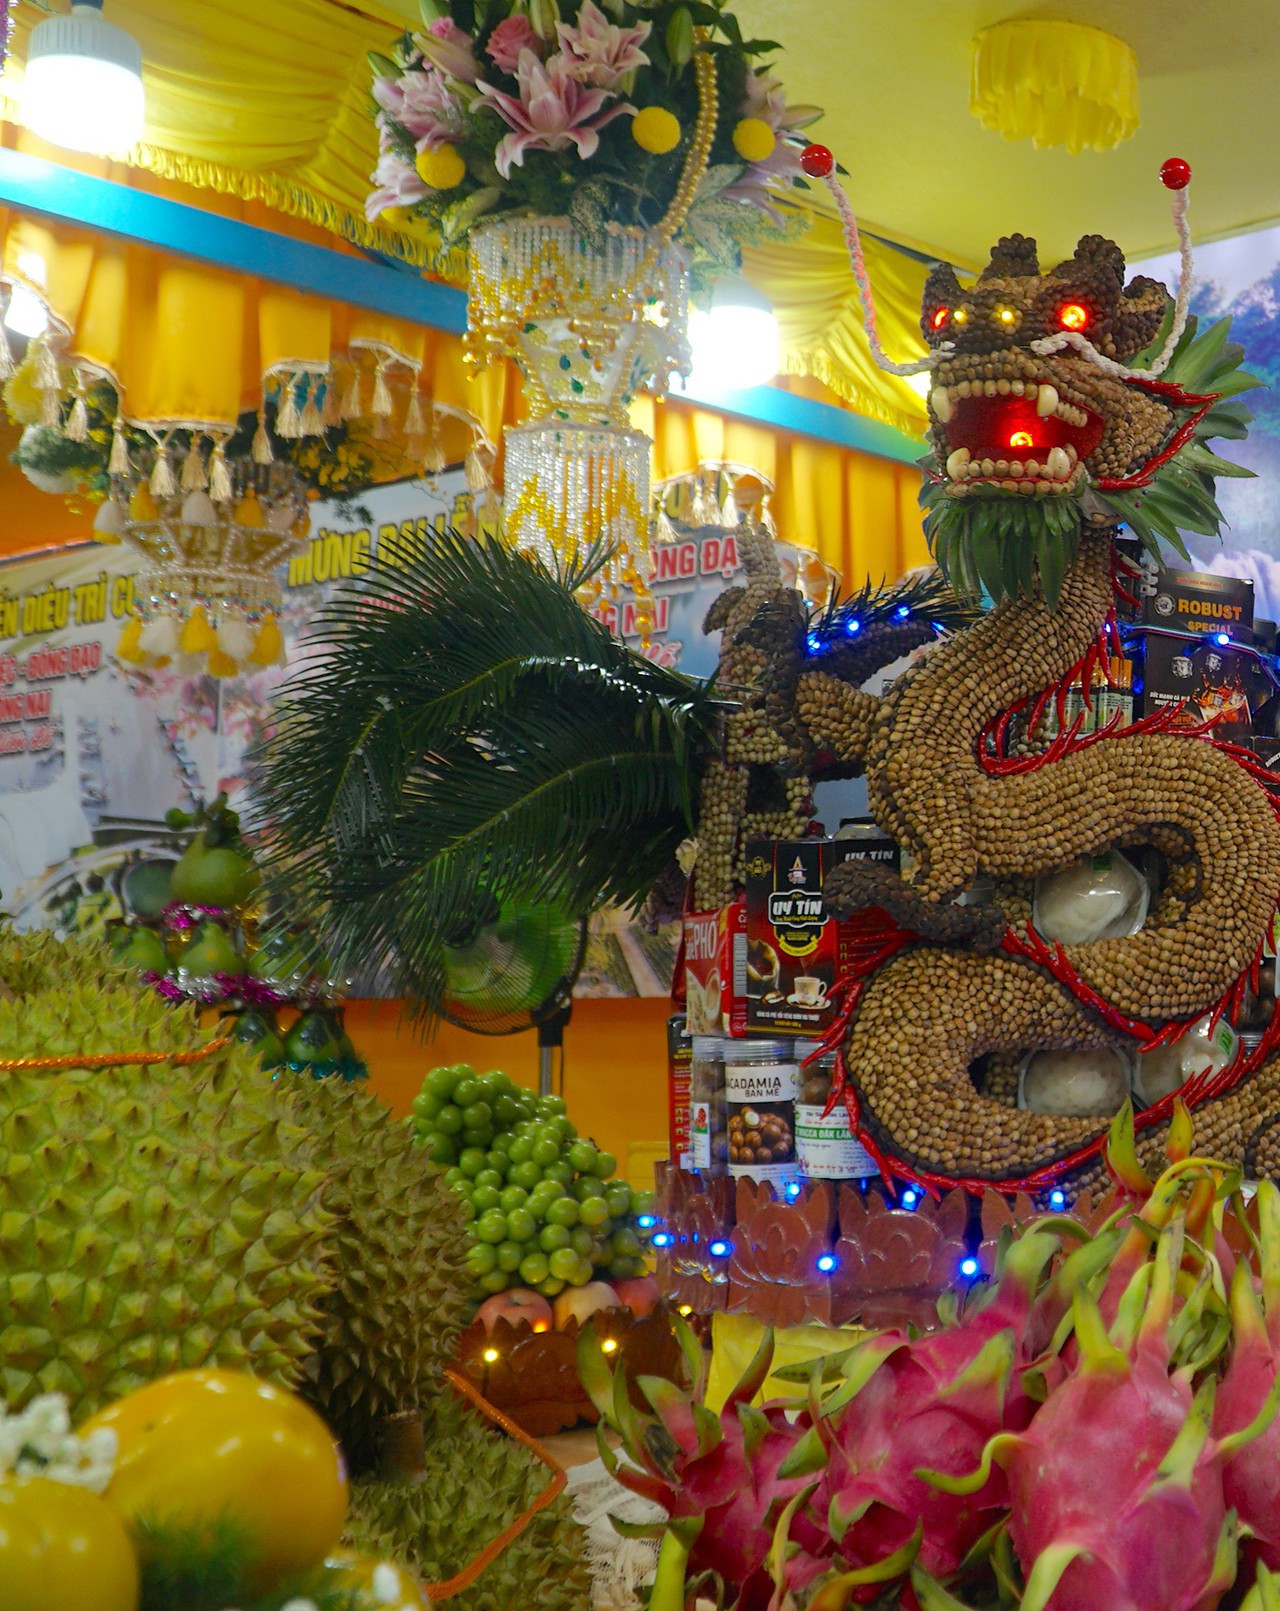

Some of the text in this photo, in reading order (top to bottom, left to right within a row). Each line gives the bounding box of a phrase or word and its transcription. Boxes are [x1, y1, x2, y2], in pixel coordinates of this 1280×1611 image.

[74, 571, 108, 626] TRÌ
[1178, 599, 1242, 621] ROBUST
[1187, 621, 1233, 636] SPECIAL
[869, 850, 894, 861] TÍN
[772, 898, 823, 916] UY TÍN
[745, 1089, 764, 1098] BAN
